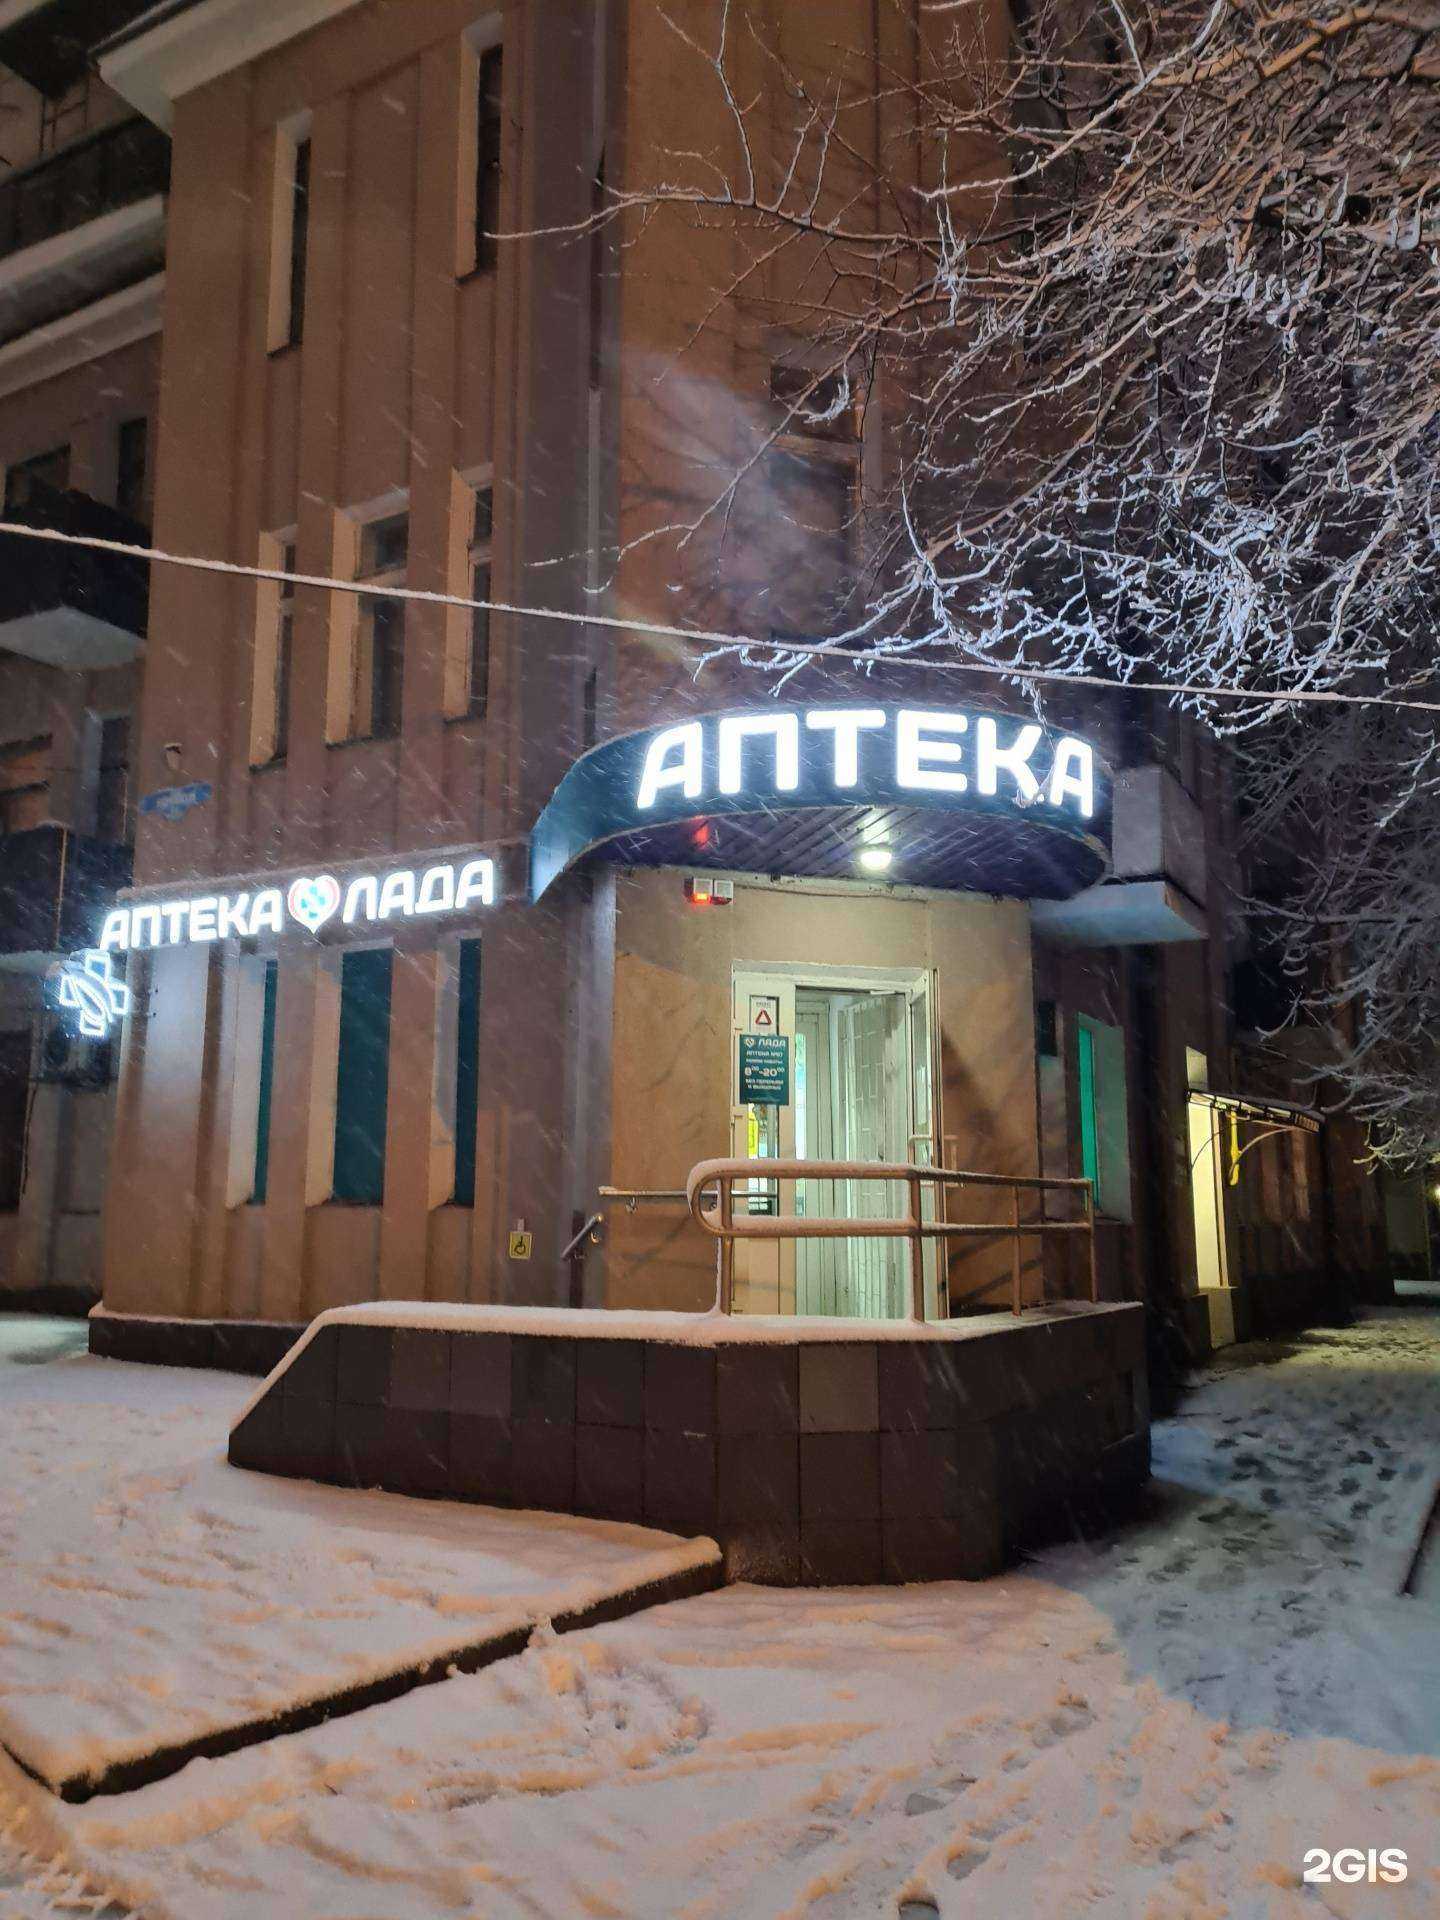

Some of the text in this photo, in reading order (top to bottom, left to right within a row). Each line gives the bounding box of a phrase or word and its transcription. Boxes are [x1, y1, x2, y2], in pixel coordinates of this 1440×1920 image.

[637, 709, 1094, 818] АПТЕКА
[100, 858, 495, 951] АПТЕКА ЛАДА
[758, 1038, 786, 1048] ЛАДА
